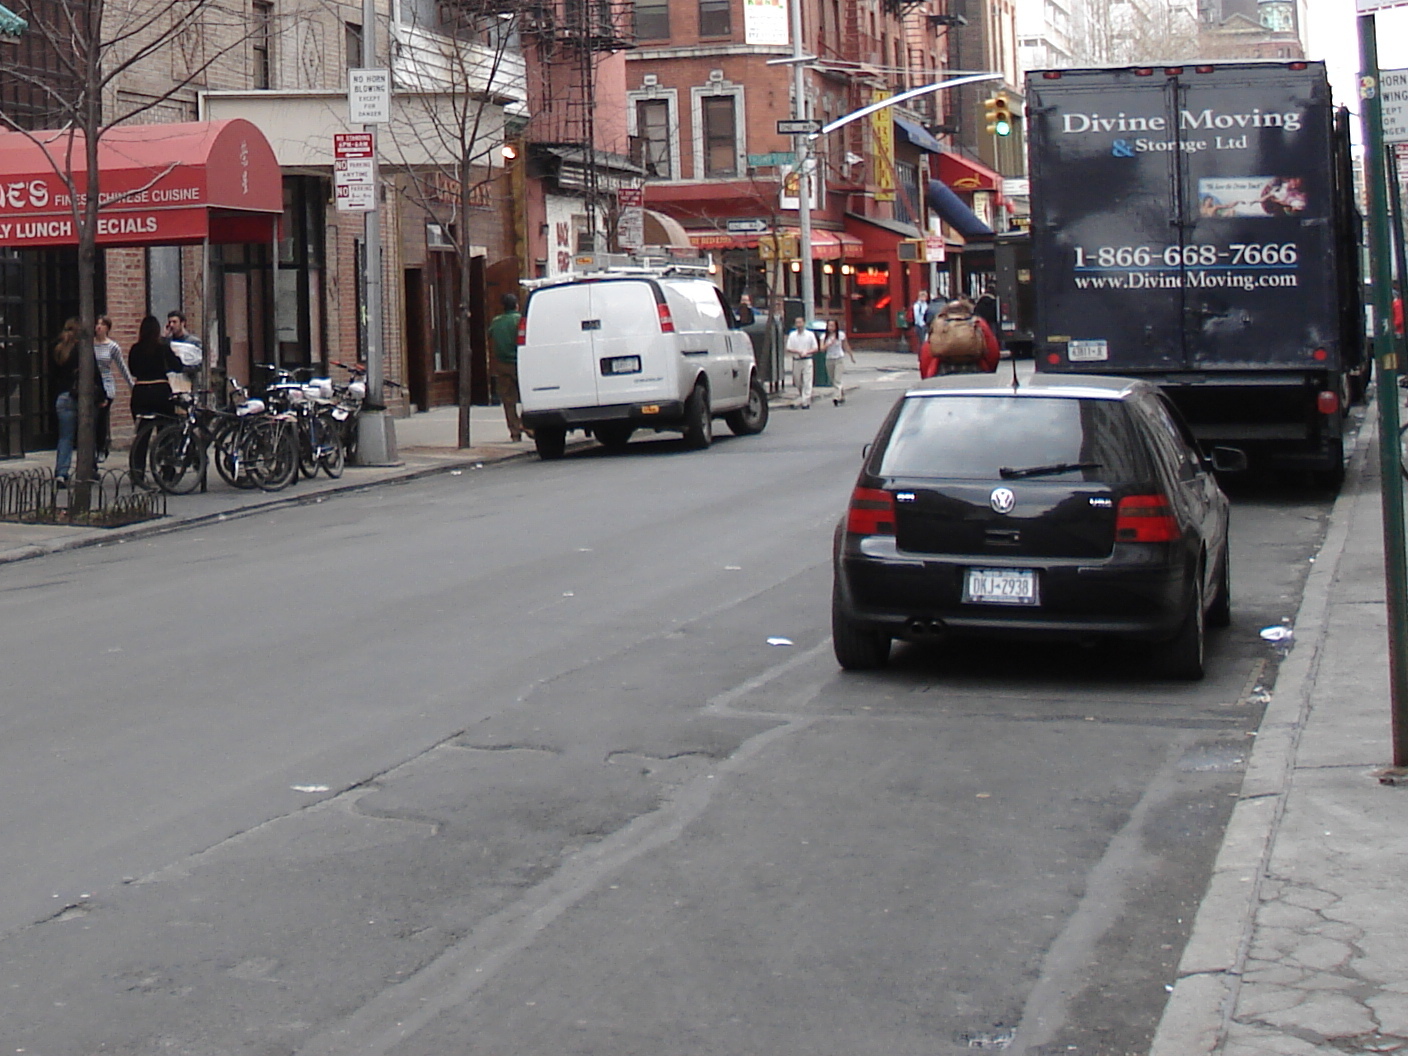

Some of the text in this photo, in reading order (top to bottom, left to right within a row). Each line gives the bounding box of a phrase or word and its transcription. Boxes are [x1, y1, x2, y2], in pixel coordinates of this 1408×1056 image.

[353, 75, 386, 83] NO HORN
[354, 84, 386, 94] BLOWING
[358, 95, 381, 103] EXCEPT
[1382, 90, 1408, 101] WING
[1062, 108, 1302, 134] Divine Moving
[1112, 139, 1135, 158] &
[1215, 135, 1248, 150] Ltd
[335, 160, 348, 171] NO
[53, 193, 89, 207] FINES
[151, 186, 201, 202] CUISINE
[337, 186, 349, 197] NO
[16, 220, 72, 239] LUNCH
[85, 216, 158, 235] ECIALS
[1074, 243, 1298, 267] 1-866-668-7666
